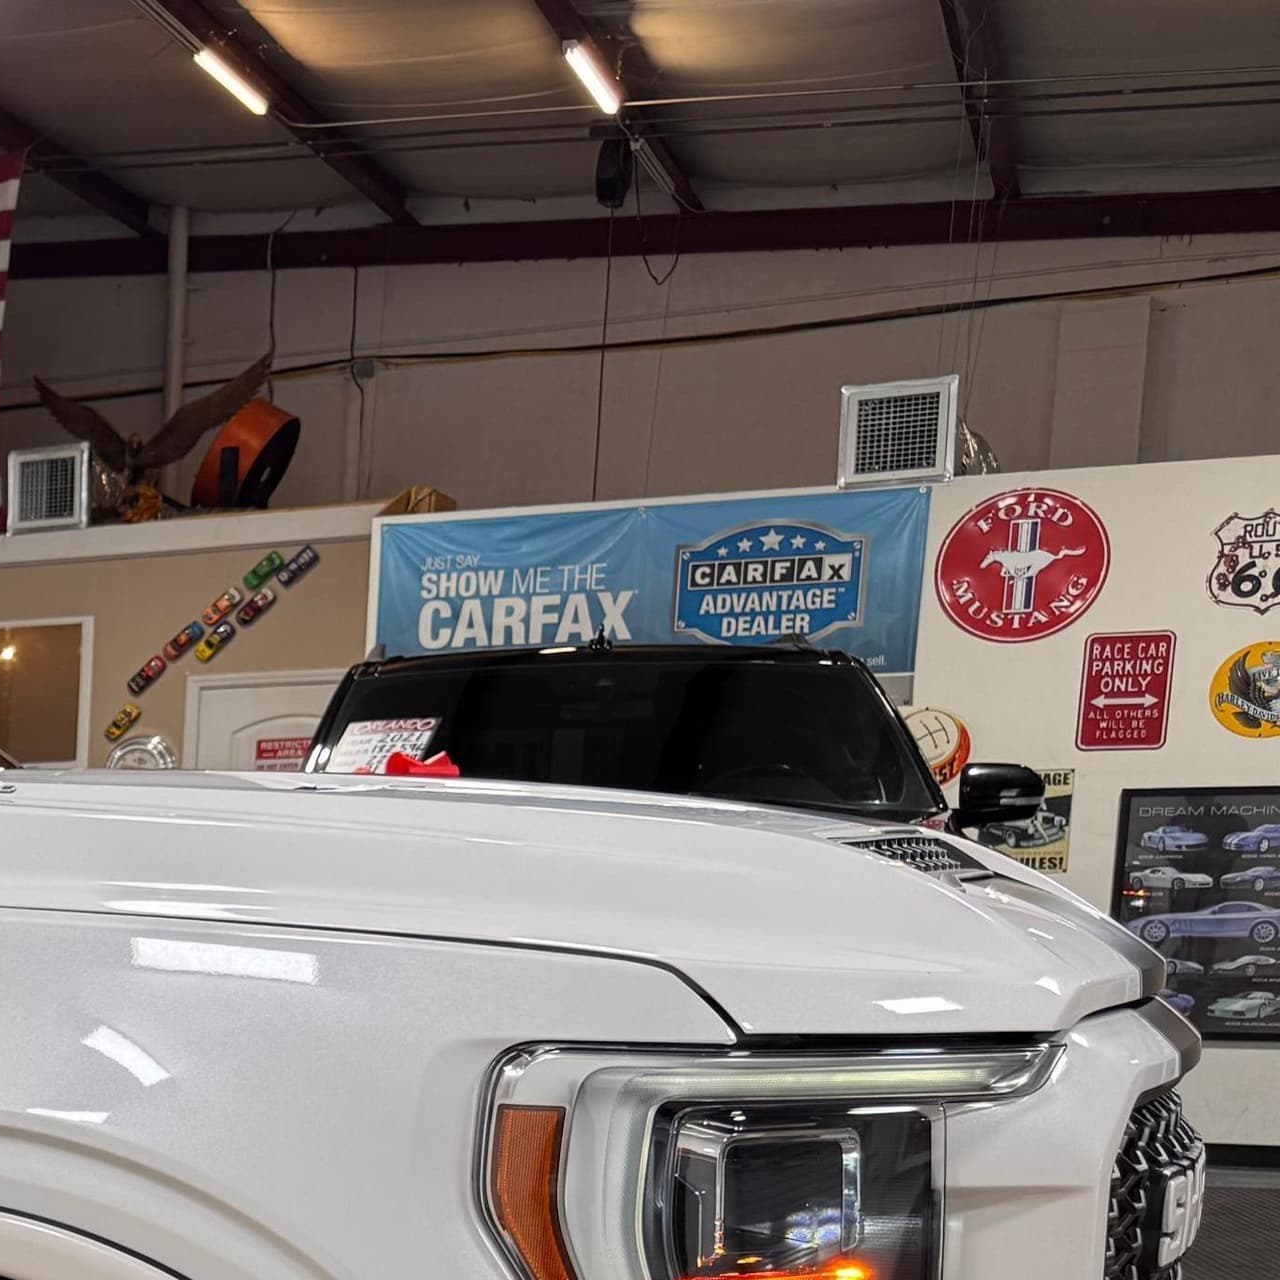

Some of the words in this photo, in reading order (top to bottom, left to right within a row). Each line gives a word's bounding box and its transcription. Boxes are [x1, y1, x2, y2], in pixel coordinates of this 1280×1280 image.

[977, 502, 1073, 533] FORD
[1244, 521, 1280, 539] ROU
[421, 556, 451, 571] JUST
[456, 554, 480, 567] SAY
[693, 555, 849, 586] CARFAX
[421, 570, 504, 599] SHOW
[512, 566, 551, 594] ME
[559, 563, 607, 591] THE
[1231, 560, 1280, 598] 6
[952, 574, 1088, 629] MUSTANG
[418, 591, 635, 650] CARFAX
[721, 614, 810, 638] DEALER
[1093, 643, 1132, 660] RACE
[1138, 642, 1167, 658] CAR
[1092, 659, 1163, 676] PARKING
[1100, 676, 1151, 692] ONLY
[1088, 711, 1109, 720] ALL
[1115, 709, 1159, 719] OTHERS
[1099, 720, 1125, 729] WILL
[1131, 719, 1145, 728] BE
[1096, 730, 1147, 739] FLAGGED
[1139, 806, 1204, 817] DREAM
[1017, 856, 1064, 870] ULES!
